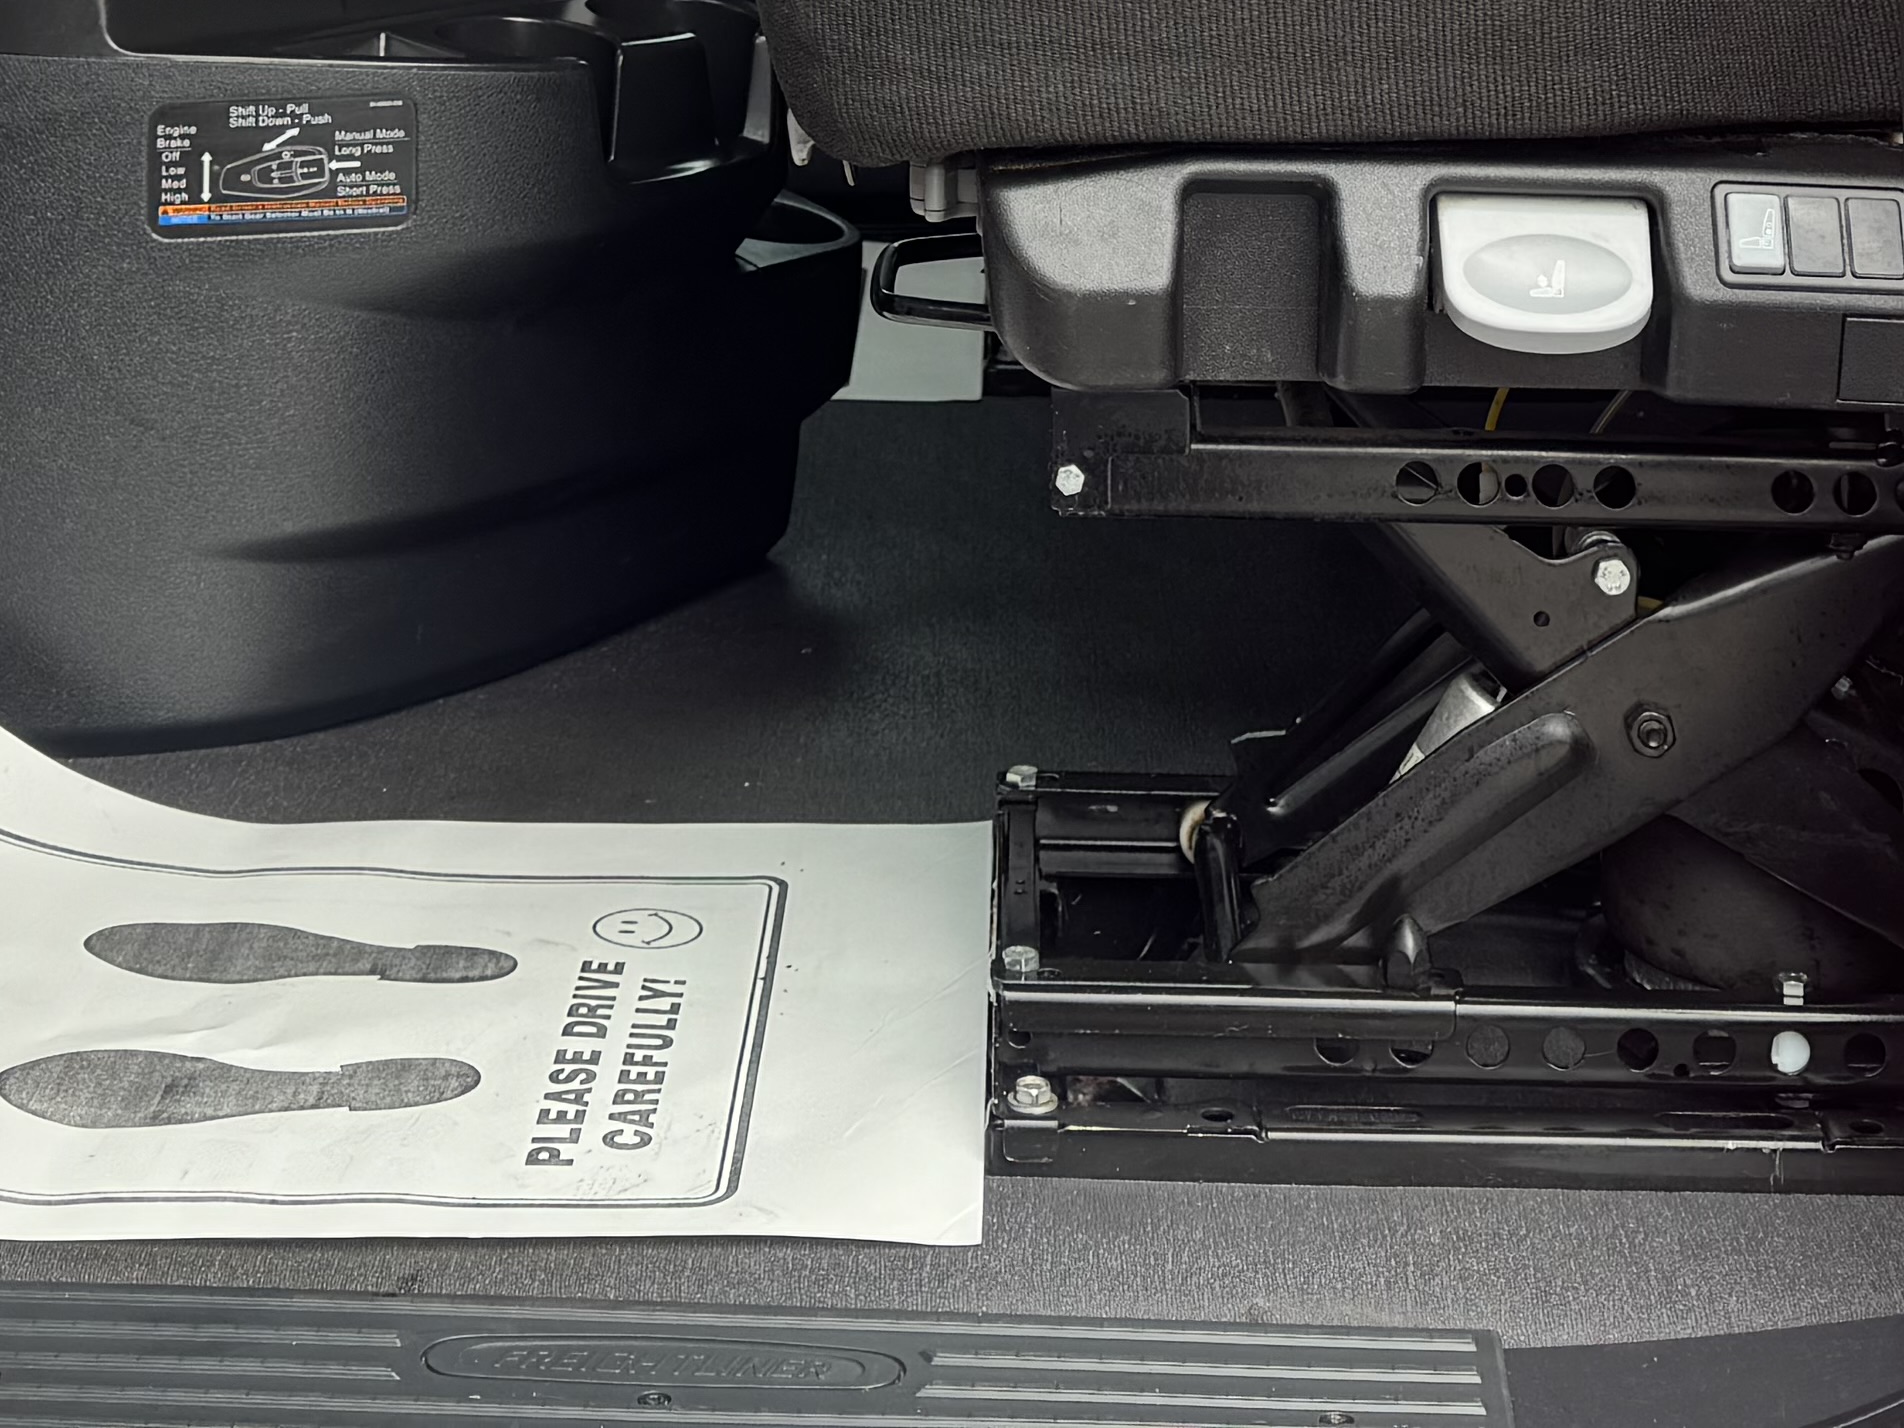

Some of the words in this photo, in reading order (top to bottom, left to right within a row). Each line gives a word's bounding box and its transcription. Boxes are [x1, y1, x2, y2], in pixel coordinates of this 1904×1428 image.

[229, 105, 256, 117] Shift
[259, 105, 276, 117] Up
[286, 103, 309, 114] Pull
[229, 116, 256, 128] Shift
[258, 116, 291, 126] Down
[303, 113, 332, 124] Push
[156, 124, 197, 137] Engine
[335, 129, 374, 141] Manual
[375, 128, 406, 138] Mode
[156, 138, 191, 148] Brake
[335, 145, 361, 156] Long
[364, 144, 394, 153] Press
[161, 151, 181, 162] Off
[161, 165, 186, 175] Low
[337, 172, 362, 182] Auto
[365, 170, 396, 180] Mode
[161, 178, 187, 189] Med
[337, 185, 367, 196] Short
[369, 184, 401, 195] Press
[161, 192, 189, 204] High
[561, 960, 626, 1039] DRIVE
[602, 978, 687, 1150] CAREFULLY!
[525, 1049, 602, 1166] PLEASE
[493, 1349, 832, 1381] FREIGHTLINER
